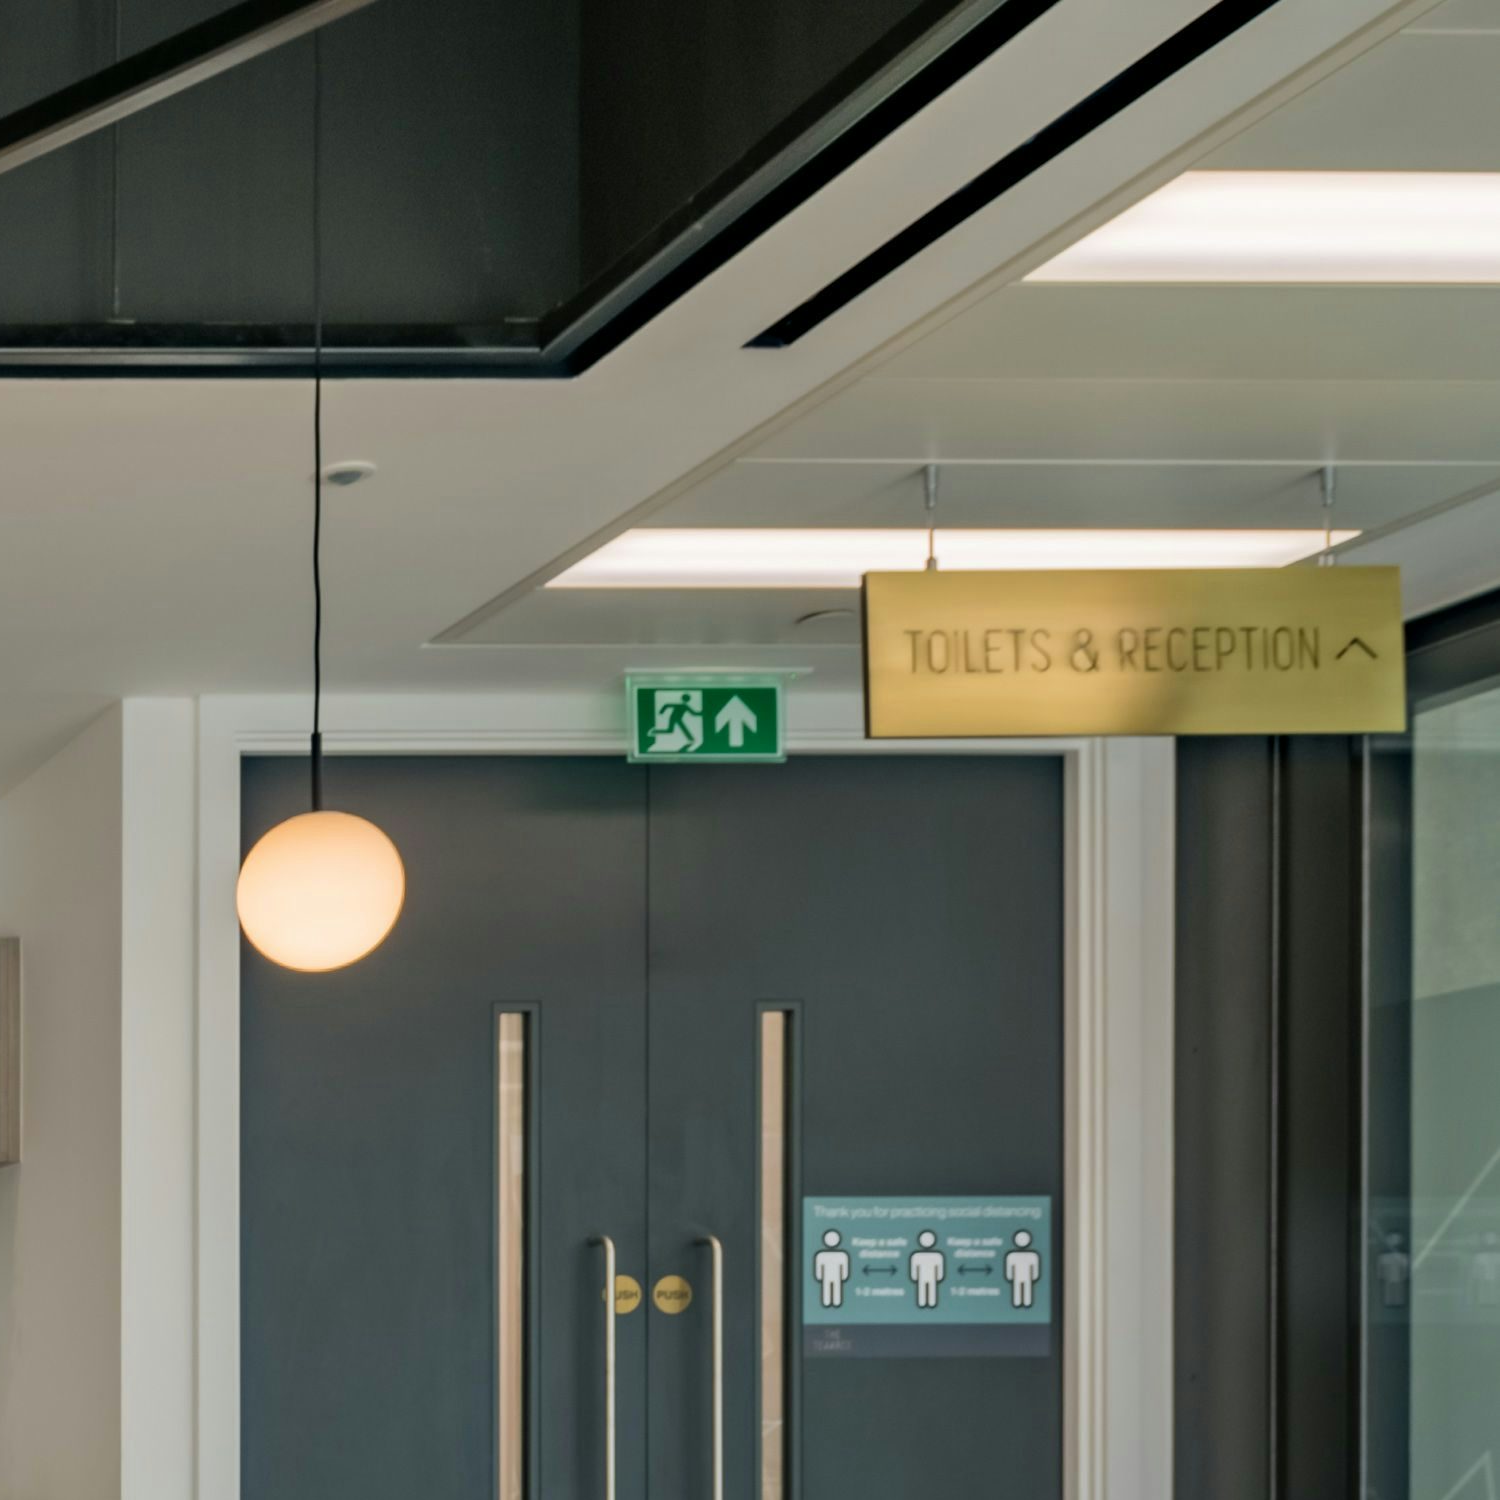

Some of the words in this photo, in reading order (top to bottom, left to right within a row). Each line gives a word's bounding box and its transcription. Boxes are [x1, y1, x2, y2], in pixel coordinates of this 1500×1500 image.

[903, 628, 1052, 676] TOILETS
[1069, 628, 1100, 675] &
[1119, 626, 1321, 673] RECEPTION
[813, 1205, 849, 1217] Thank
[850, 1207, 872, 1220] you
[873, 1205, 889, 1217] for
[948, 1205, 980, 1217] social
[983, 1205, 1042, 1220] distancing
[656, 1289, 689, 1300] PUSH
